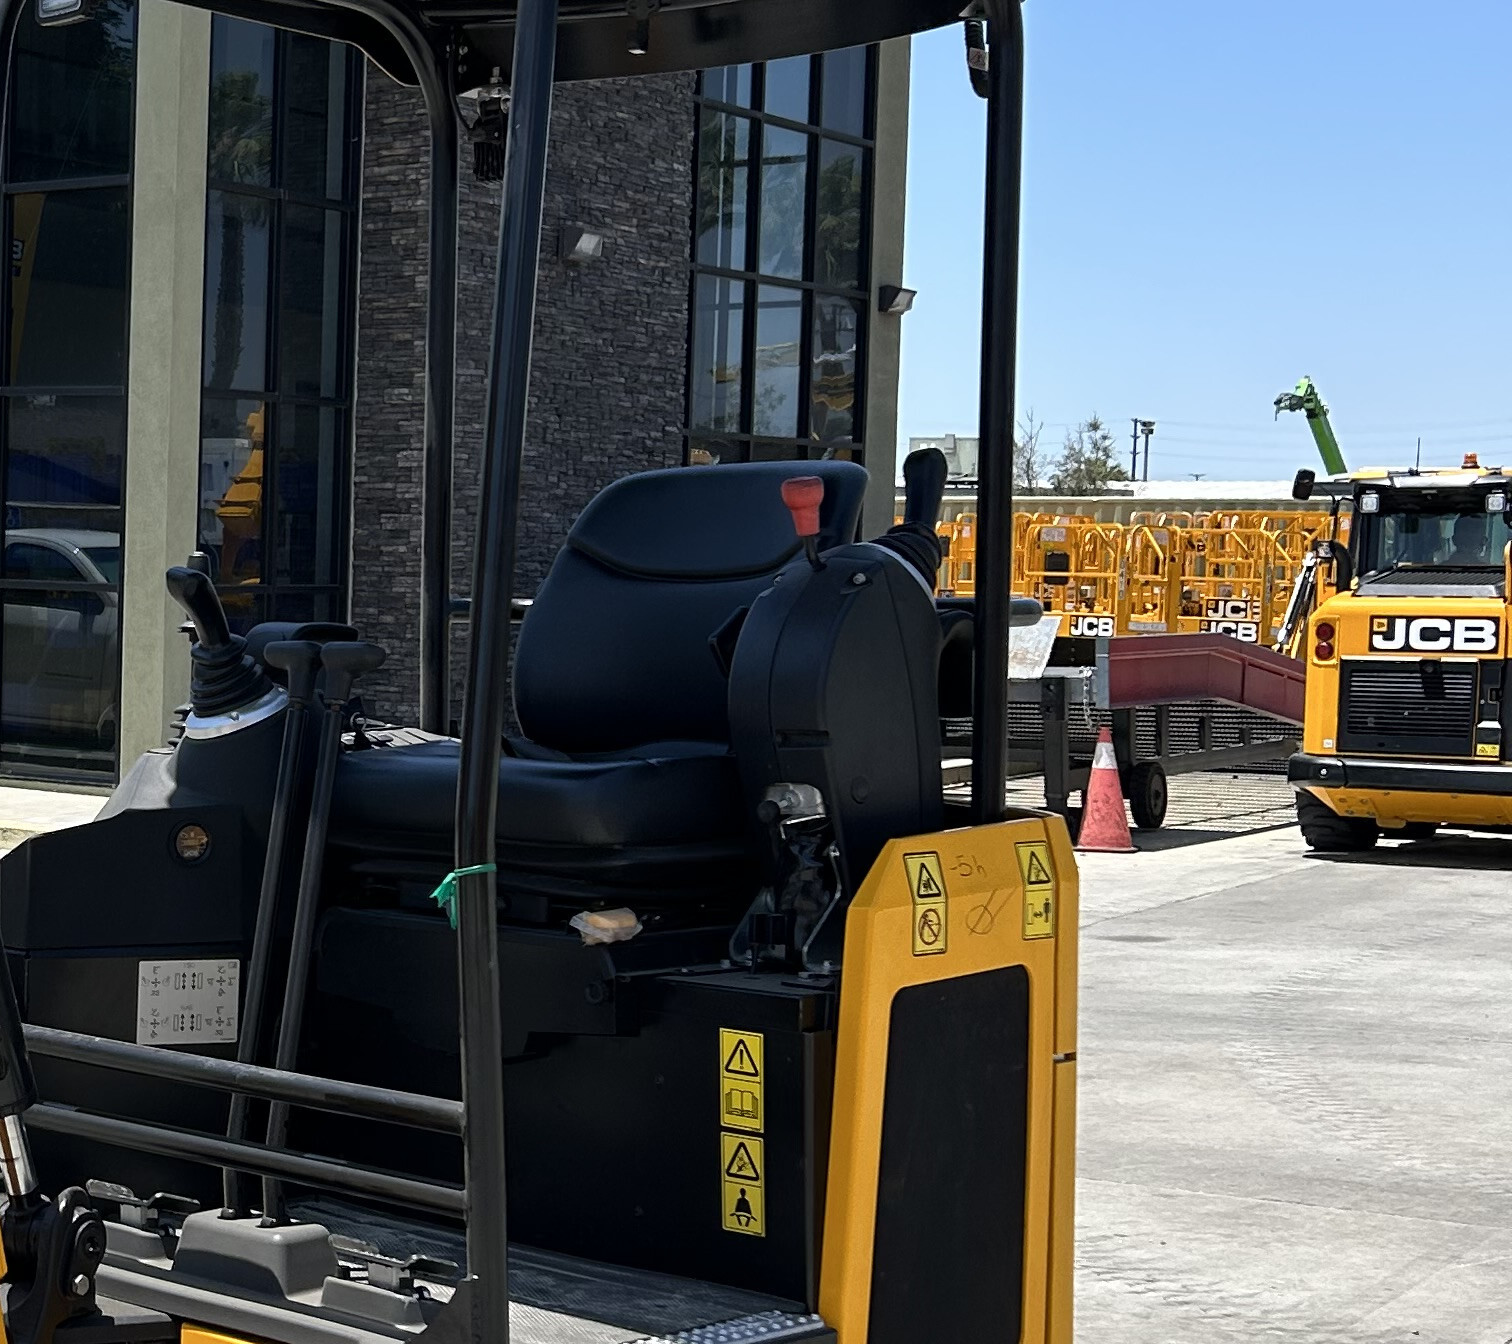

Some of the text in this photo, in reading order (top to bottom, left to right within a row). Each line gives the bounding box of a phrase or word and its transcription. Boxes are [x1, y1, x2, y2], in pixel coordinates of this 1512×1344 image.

[1070, 617, 1114, 636] JCB
[1200, 621, 1257, 642] JCB
[1372, 618, 1496, 651] JCB
